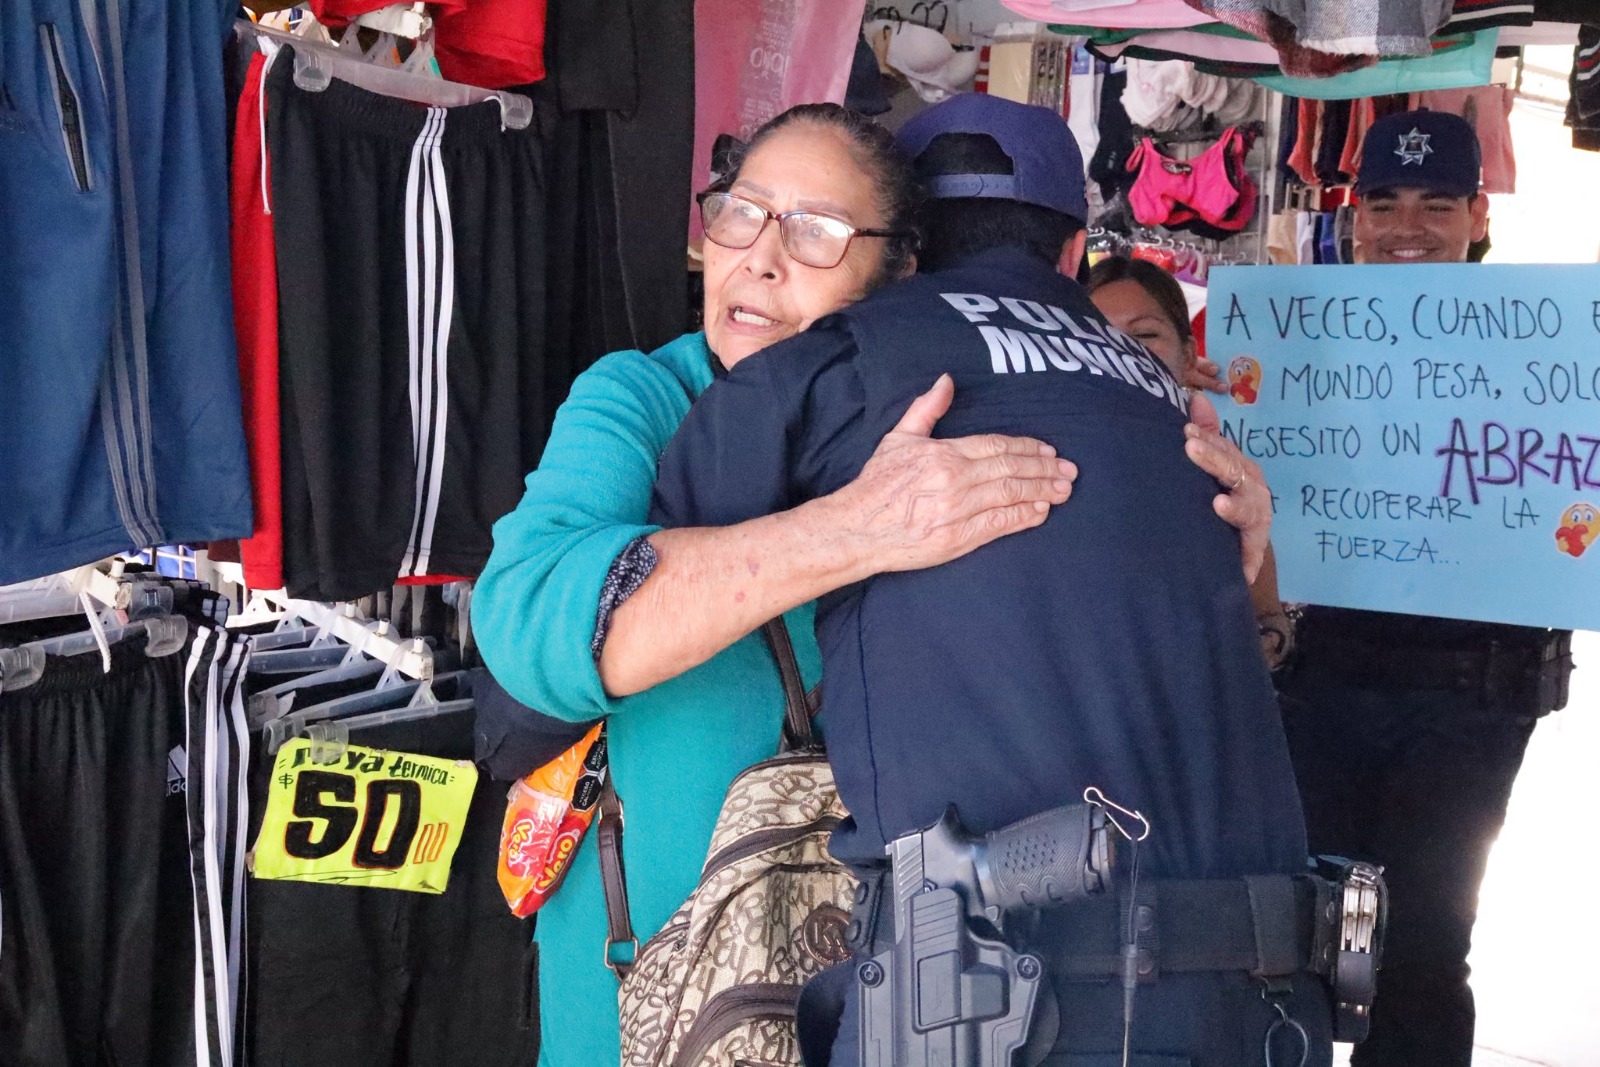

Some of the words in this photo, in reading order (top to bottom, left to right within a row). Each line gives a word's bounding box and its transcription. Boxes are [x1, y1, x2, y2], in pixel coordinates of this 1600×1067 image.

[939, 292, 1172, 384] POLICI
[1223, 292, 1252, 341] A
[1269, 296, 1398, 345] VECES,
[1412, 294, 1562, 340] CUANDO
[1281, 361, 1393, 406] MUNDO
[1413, 358, 1502, 401] PESA,
[1219, 417, 1361, 459] NESESITO
[1382, 423, 1422, 456] UN
[1301, 484, 1472, 524] RECUPERAR
[1502, 496, 1541, 530] LA
[1315, 530, 1460, 566] FUERZA...
[538, 838, 574, 888] Vero
